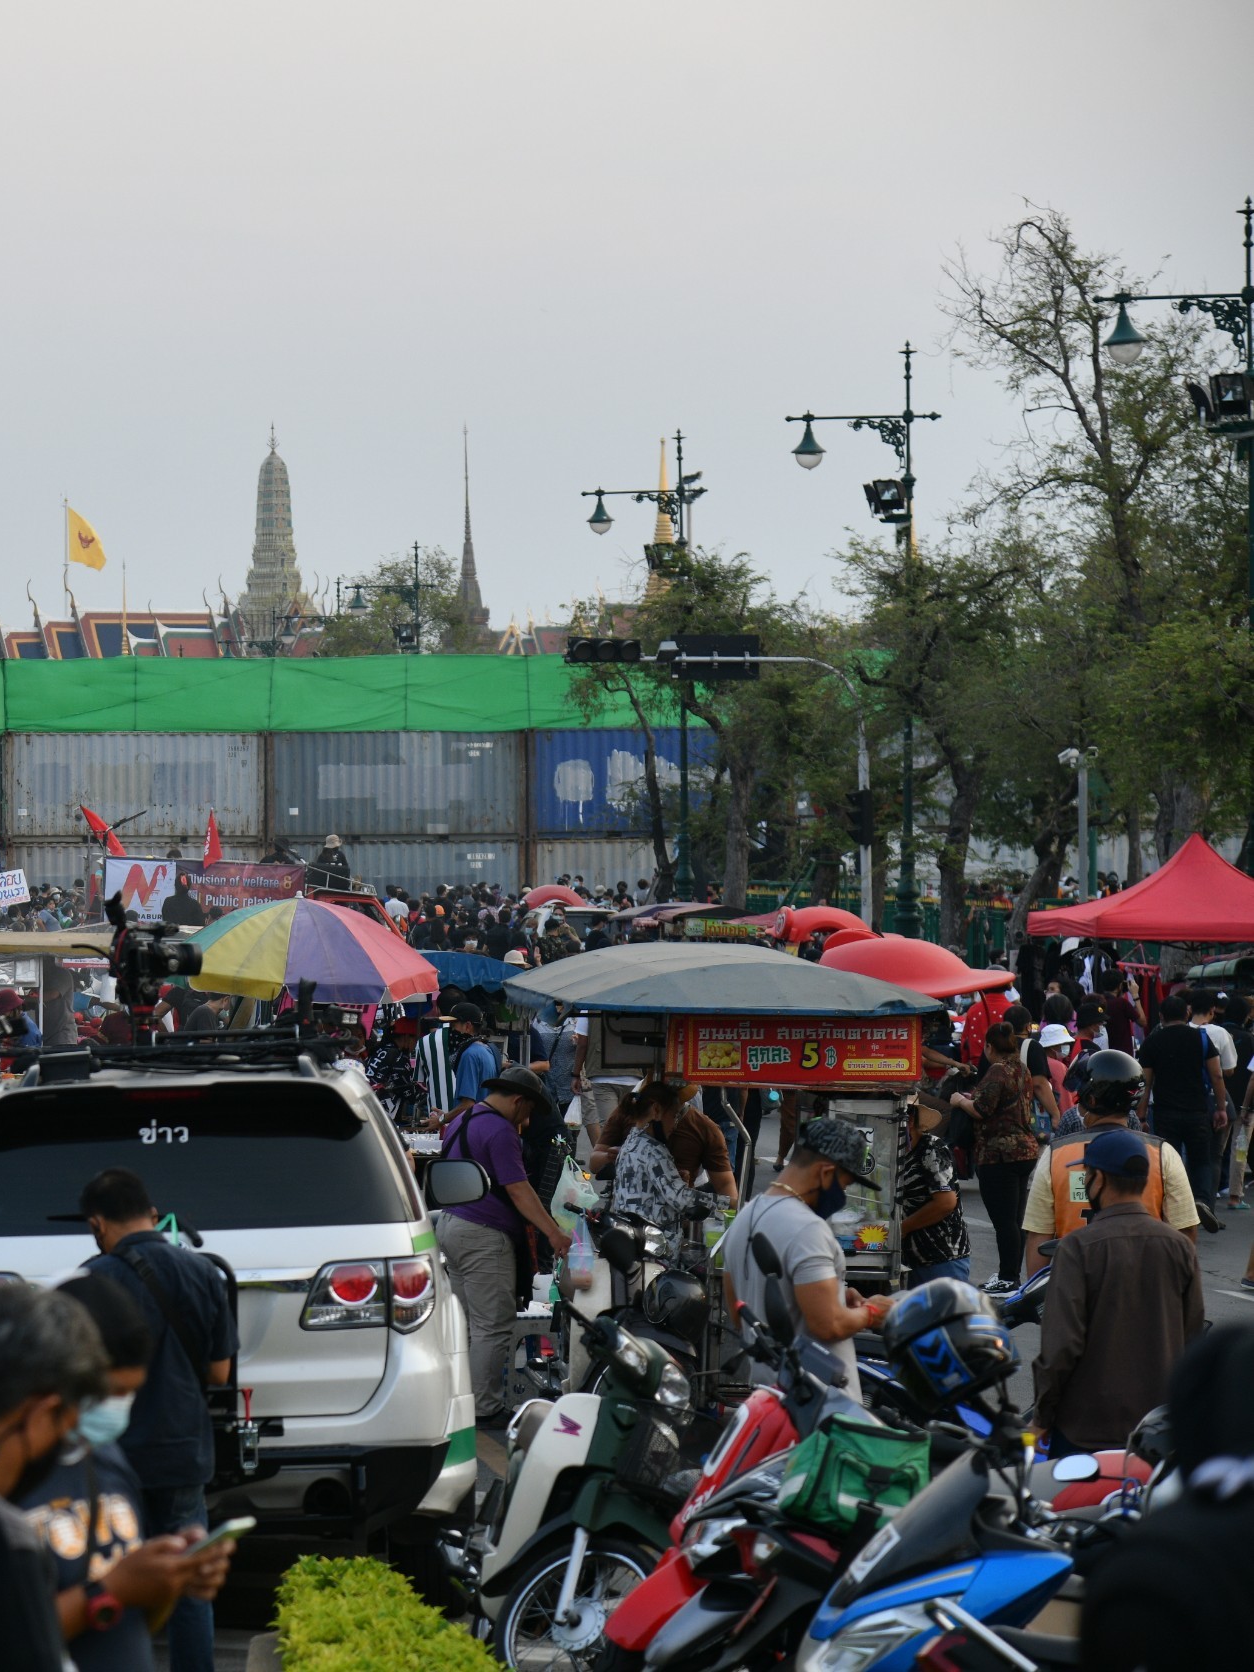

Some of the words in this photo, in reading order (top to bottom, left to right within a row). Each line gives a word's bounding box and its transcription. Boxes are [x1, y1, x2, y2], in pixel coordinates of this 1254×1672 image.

[229, 875, 240, 887] of
[242, 875, 280, 889] welfare
[205, 894, 239, 908] Public
[698, 1022, 764, 1040] ขนมจีบ
[748, 1046, 790, 1071] ลูกละ
[801, 1041, 821, 1070] 5
[138, 1118, 189, 1145] ข่าว
